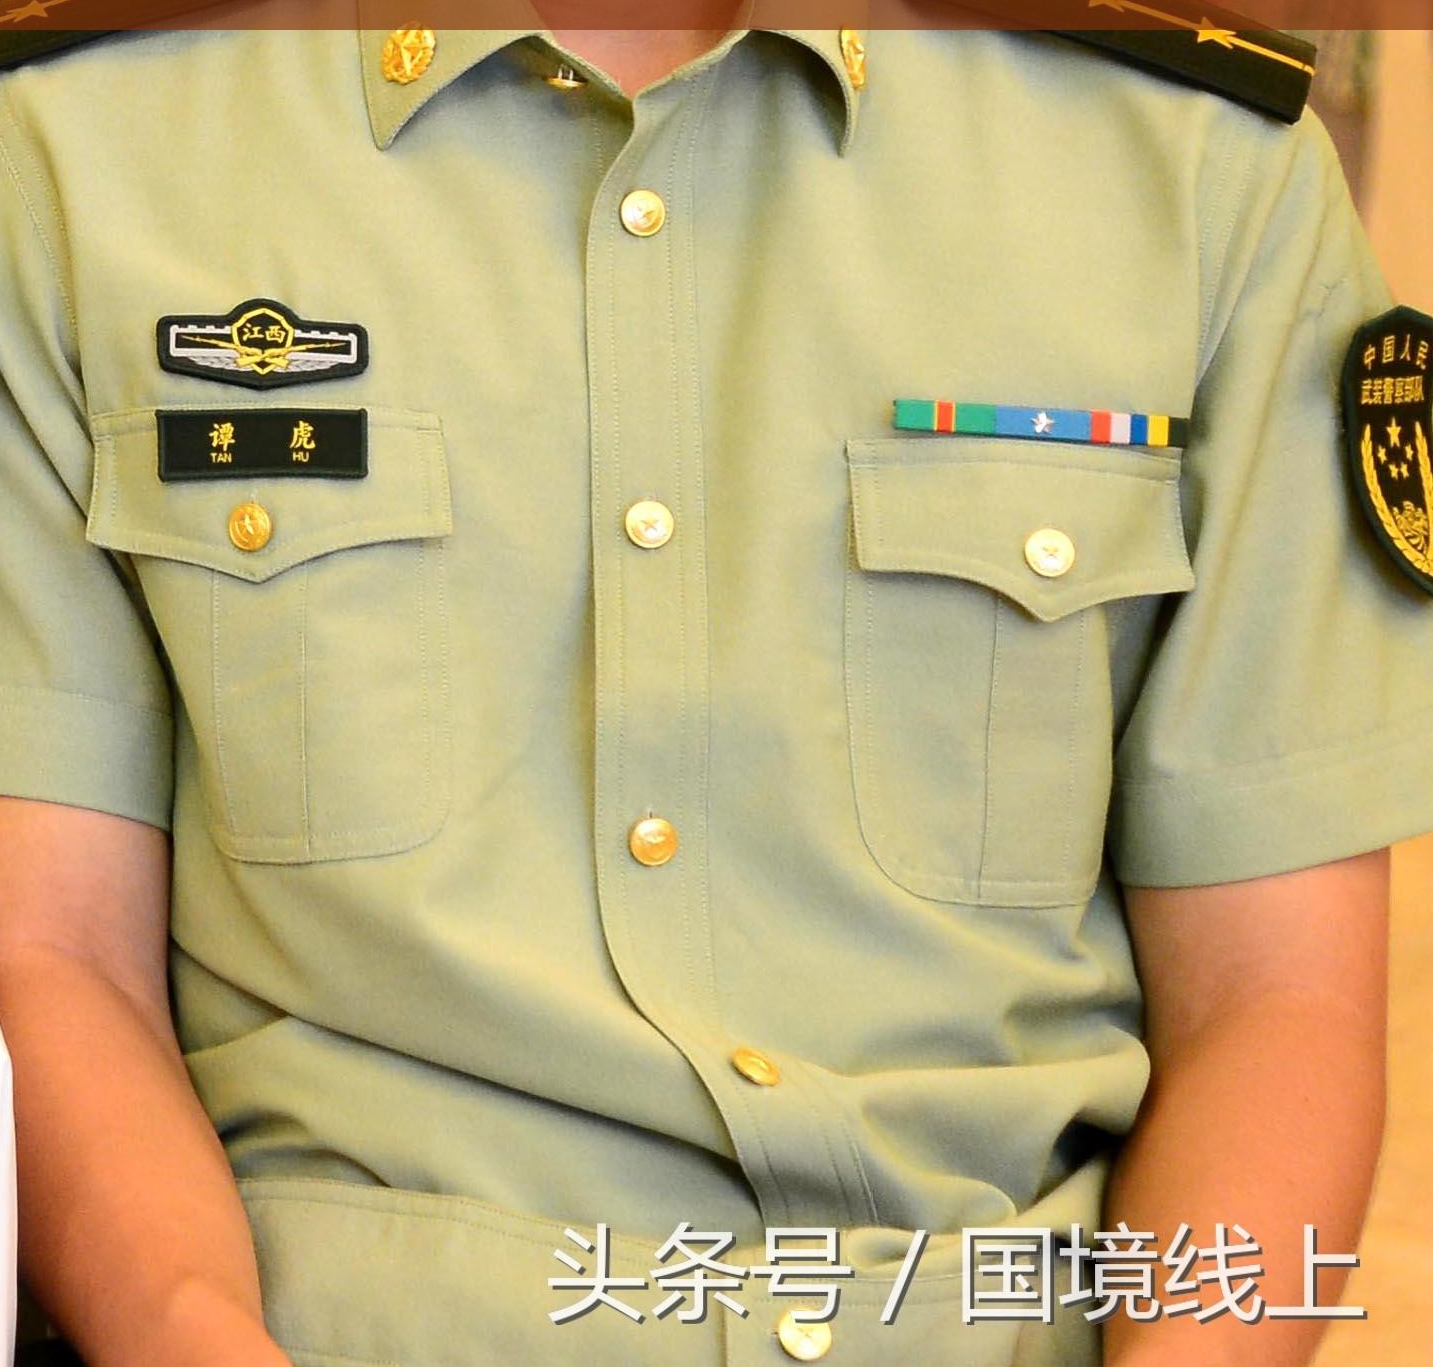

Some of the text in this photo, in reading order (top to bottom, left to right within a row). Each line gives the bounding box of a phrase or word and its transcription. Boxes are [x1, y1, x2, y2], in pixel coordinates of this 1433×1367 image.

[242, 323, 286, 344] 江西
[1364, 334, 1429, 371] 中国人民
[209, 420, 316, 452] 谭 虎
[210, 451, 310, 463] TAN HU
